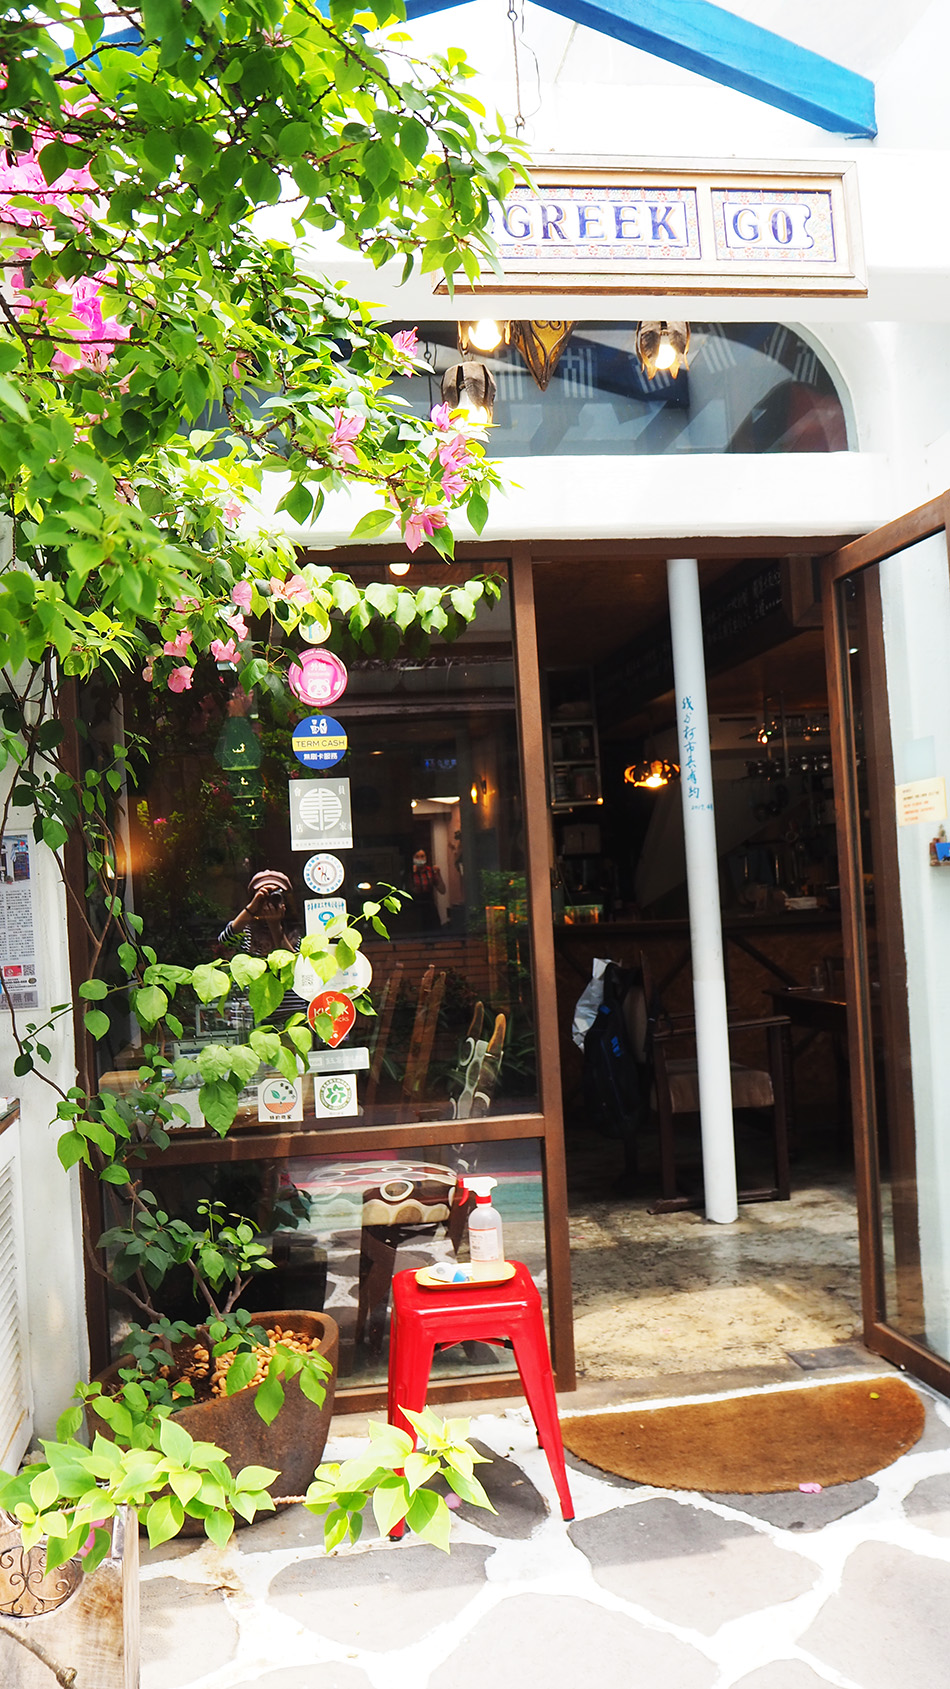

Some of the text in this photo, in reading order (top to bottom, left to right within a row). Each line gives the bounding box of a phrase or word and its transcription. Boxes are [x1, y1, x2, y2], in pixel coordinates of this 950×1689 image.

[502, 204, 794, 245] GREEK GO
[296, 739, 345, 748] TERM CASH
